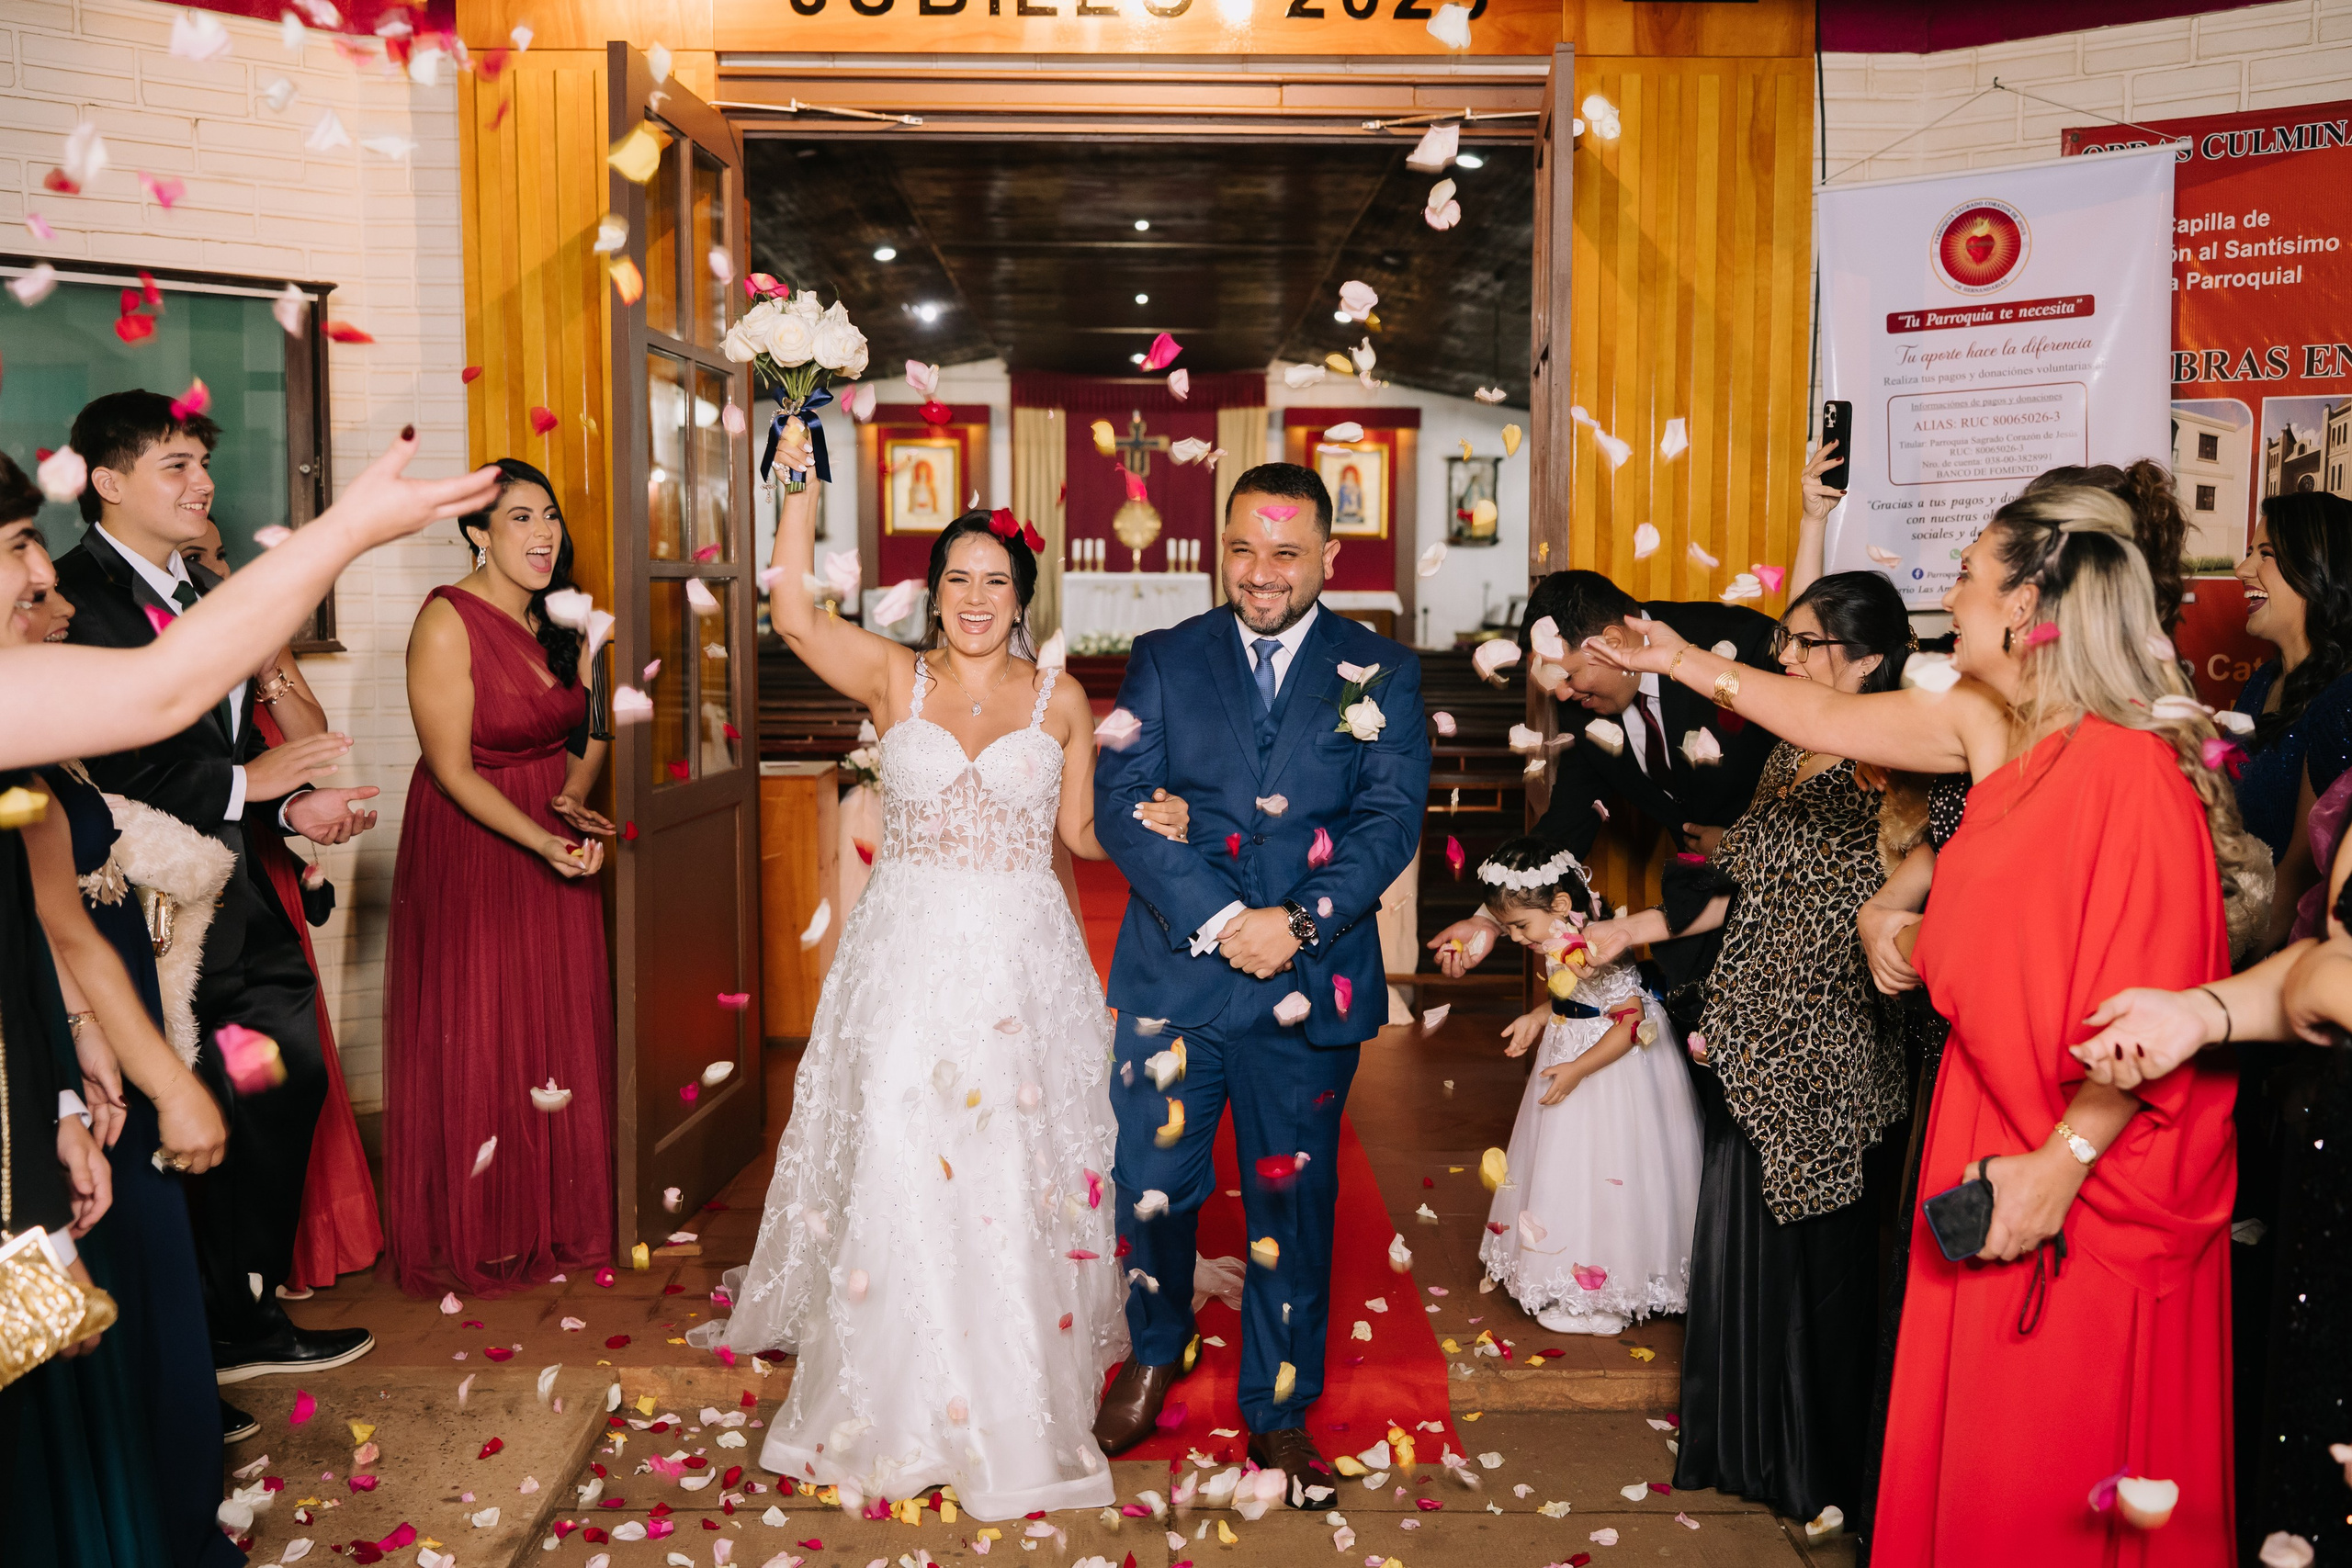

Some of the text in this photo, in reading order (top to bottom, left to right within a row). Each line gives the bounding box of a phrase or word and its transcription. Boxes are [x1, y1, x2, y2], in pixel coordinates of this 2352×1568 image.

[2201, 120, 2352, 159] CULMIN
[1955, 201, 1984, 215] SAGRADO
[2173, 209, 2270, 236] apilla de
[2199, 242, 2217, 261] al
[2224, 236, 2340, 259] Santísimo
[2187, 265, 2302, 290] Parroquial
[1926, 308, 1994, 327] Parroquia
[1999, 307, 2013, 319] te
[1894, 335, 2093, 370] Tu aporte hace la diferencia
[1883, 374, 1919, 387] Realiza
[1921, 373, 1936, 383] tus
[1938, 372, 1966, 384] pagos
[1969, 372, 1976, 382] y
[1978, 366, 2033, 378] donaciónes
[2037, 362, 2092, 374] voluntarias
[1971, 399, 1981, 407] de
[1983, 398, 2007, 408] pagos
[2008, 397, 2015, 405] y
[1913, 411, 2060, 432] ALIAS: RUC 80065026-3
[1899, 441, 1927, 449] Titular:
[1929, 437, 1969, 448] Parroquia
[1971, 435, 2004, 446] Sagrado
[2006, 432, 2041, 442] Corazón
[2043, 431, 2053, 439] de
[1950, 447, 1973, 457] RUC:
[1922, 460, 1939, 469] Nro.
[1941, 459, 1951, 468] de
[1953, 458, 1983, 468] cuenta:
[1936, 465, 2039, 479] BANCO DE FOMENTO
[1930, 499, 1946, 507] tus
[1951, 496, 1984, 509] pagos
[1988, 496, 1996, 506] y
[1906, 516, 1926, 525] con
[1930, 513, 1978, 524] nuestras
[1911, 528, 1954, 540] sociales
[1956, 530, 1965, 540] y
[1918, 585, 1935, 594] Las
